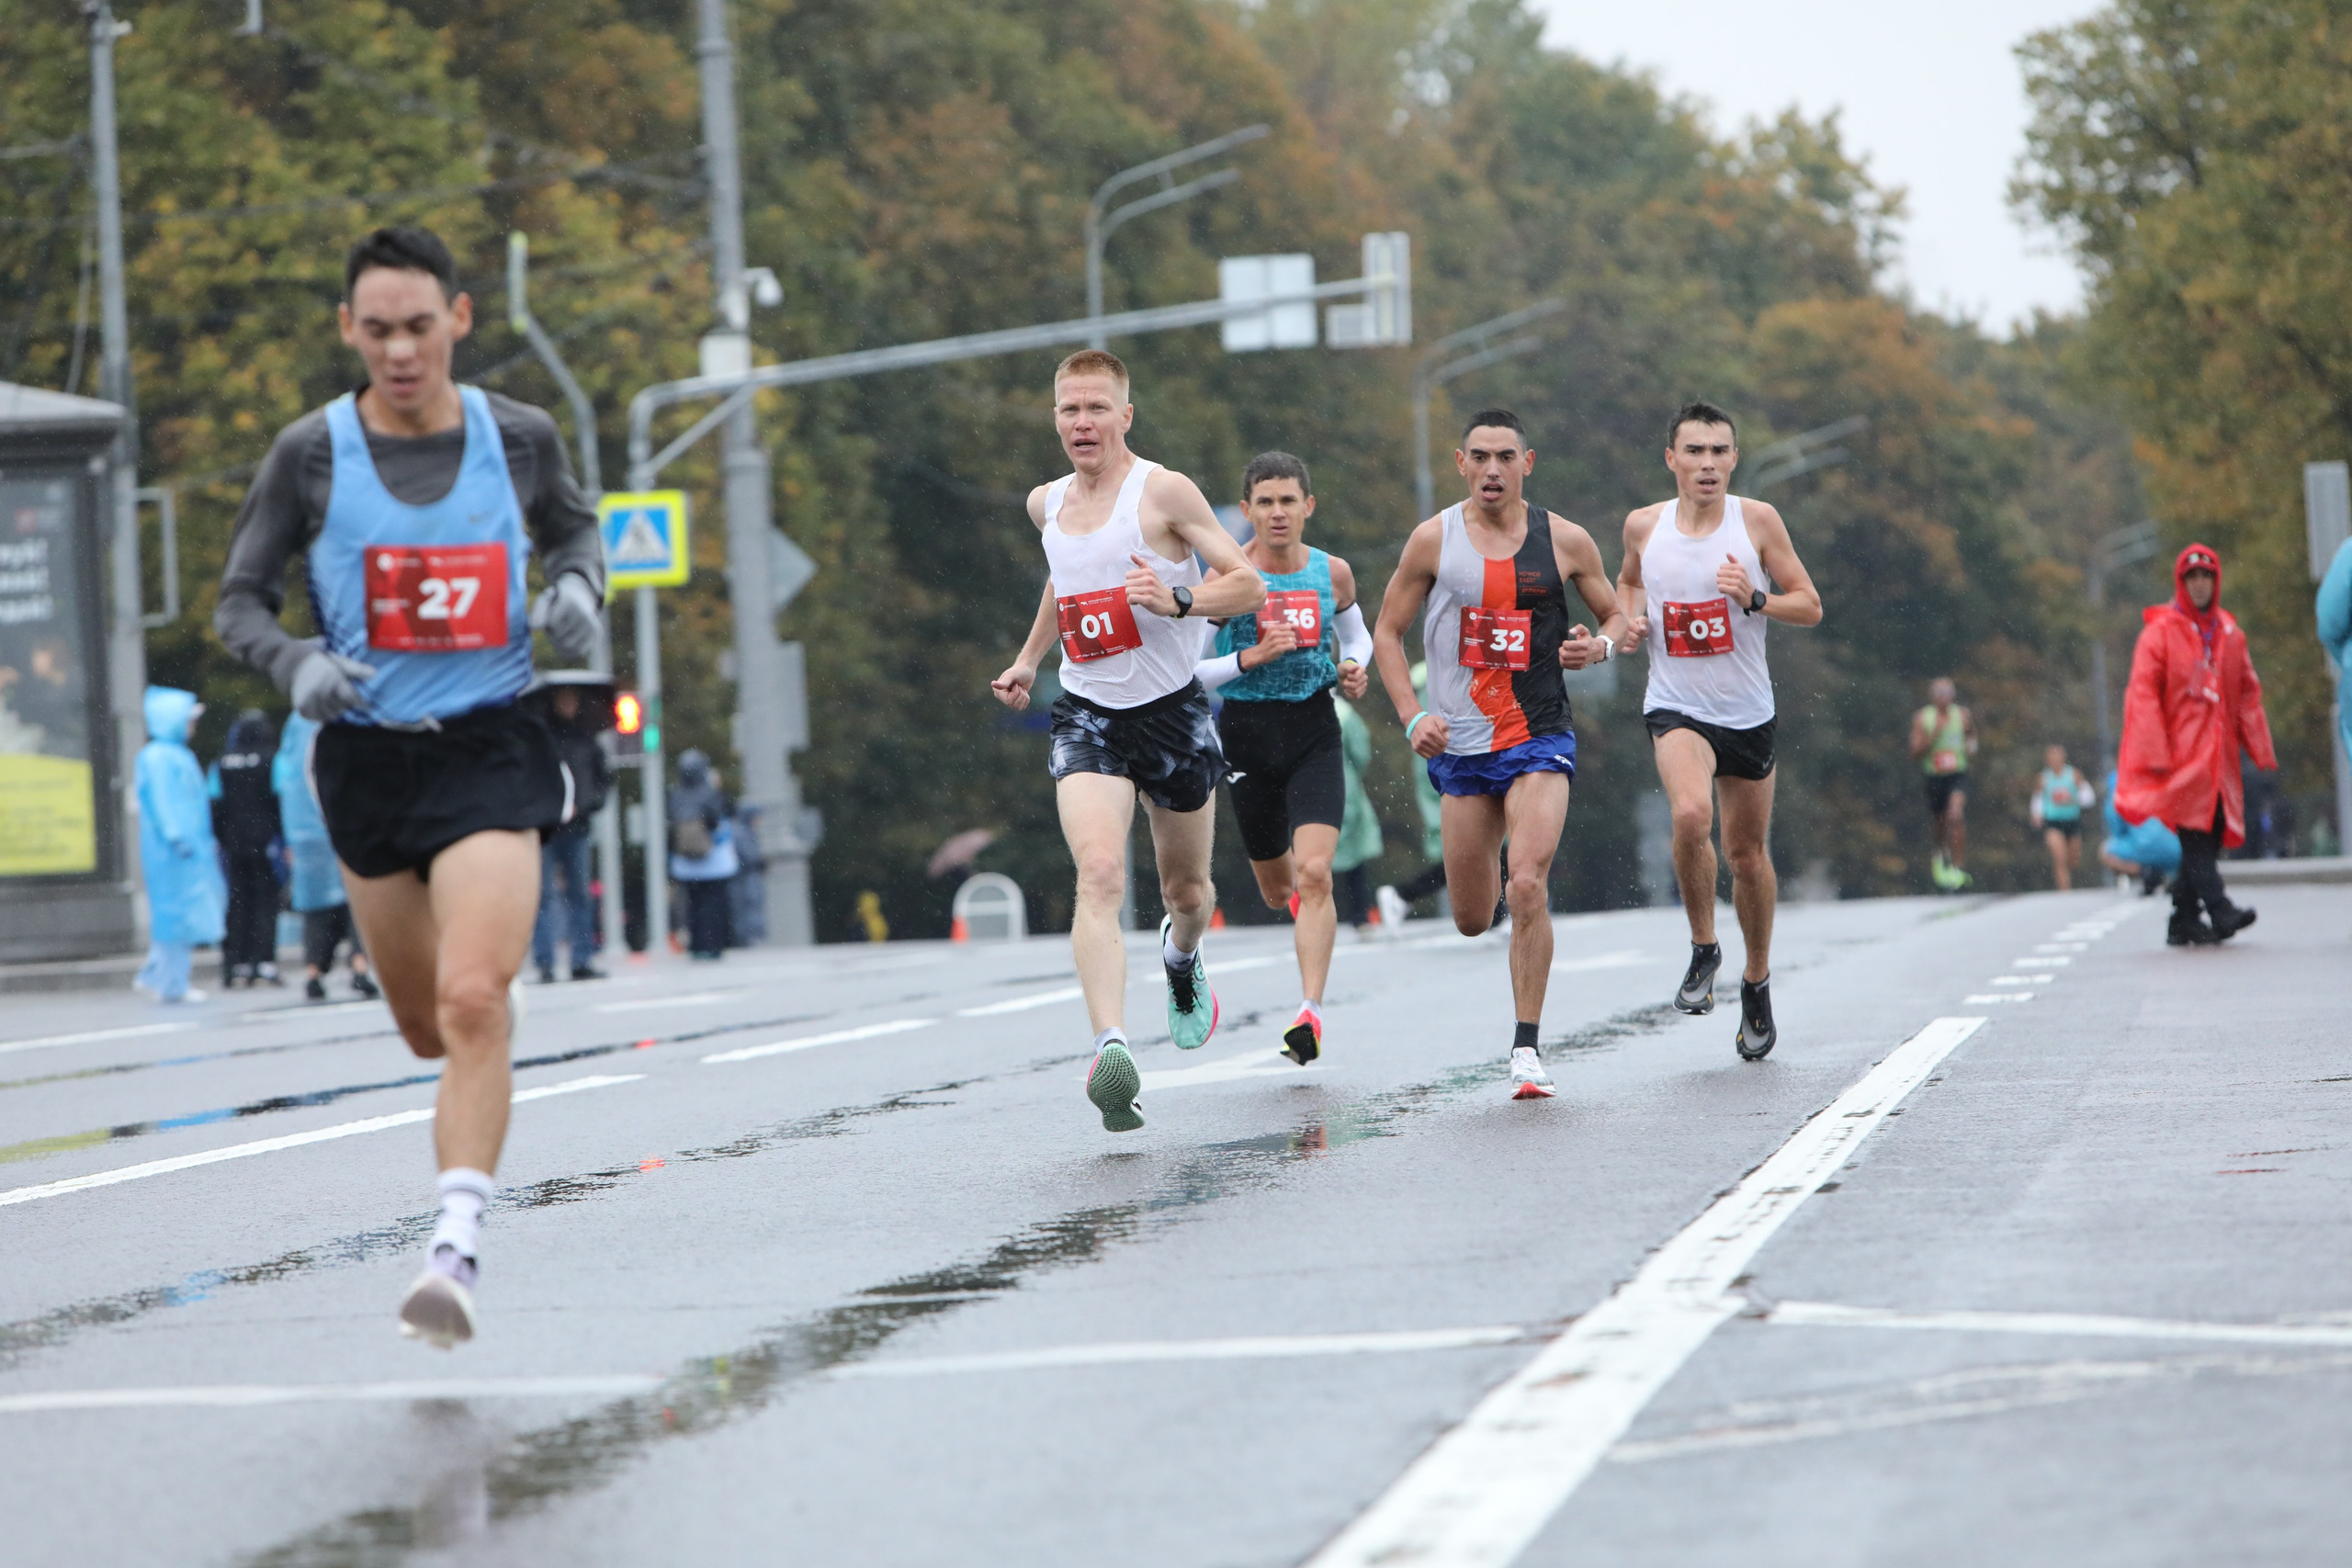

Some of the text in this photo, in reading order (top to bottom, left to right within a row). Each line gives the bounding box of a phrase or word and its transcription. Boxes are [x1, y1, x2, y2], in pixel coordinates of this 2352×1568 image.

[417, 576, 481, 620] 27
[1080, 611, 1114, 639] 01
[1283, 607, 1316, 630] 36
[1690, 616, 1726, 640] 03
[1489, 628, 1525, 652] 32
